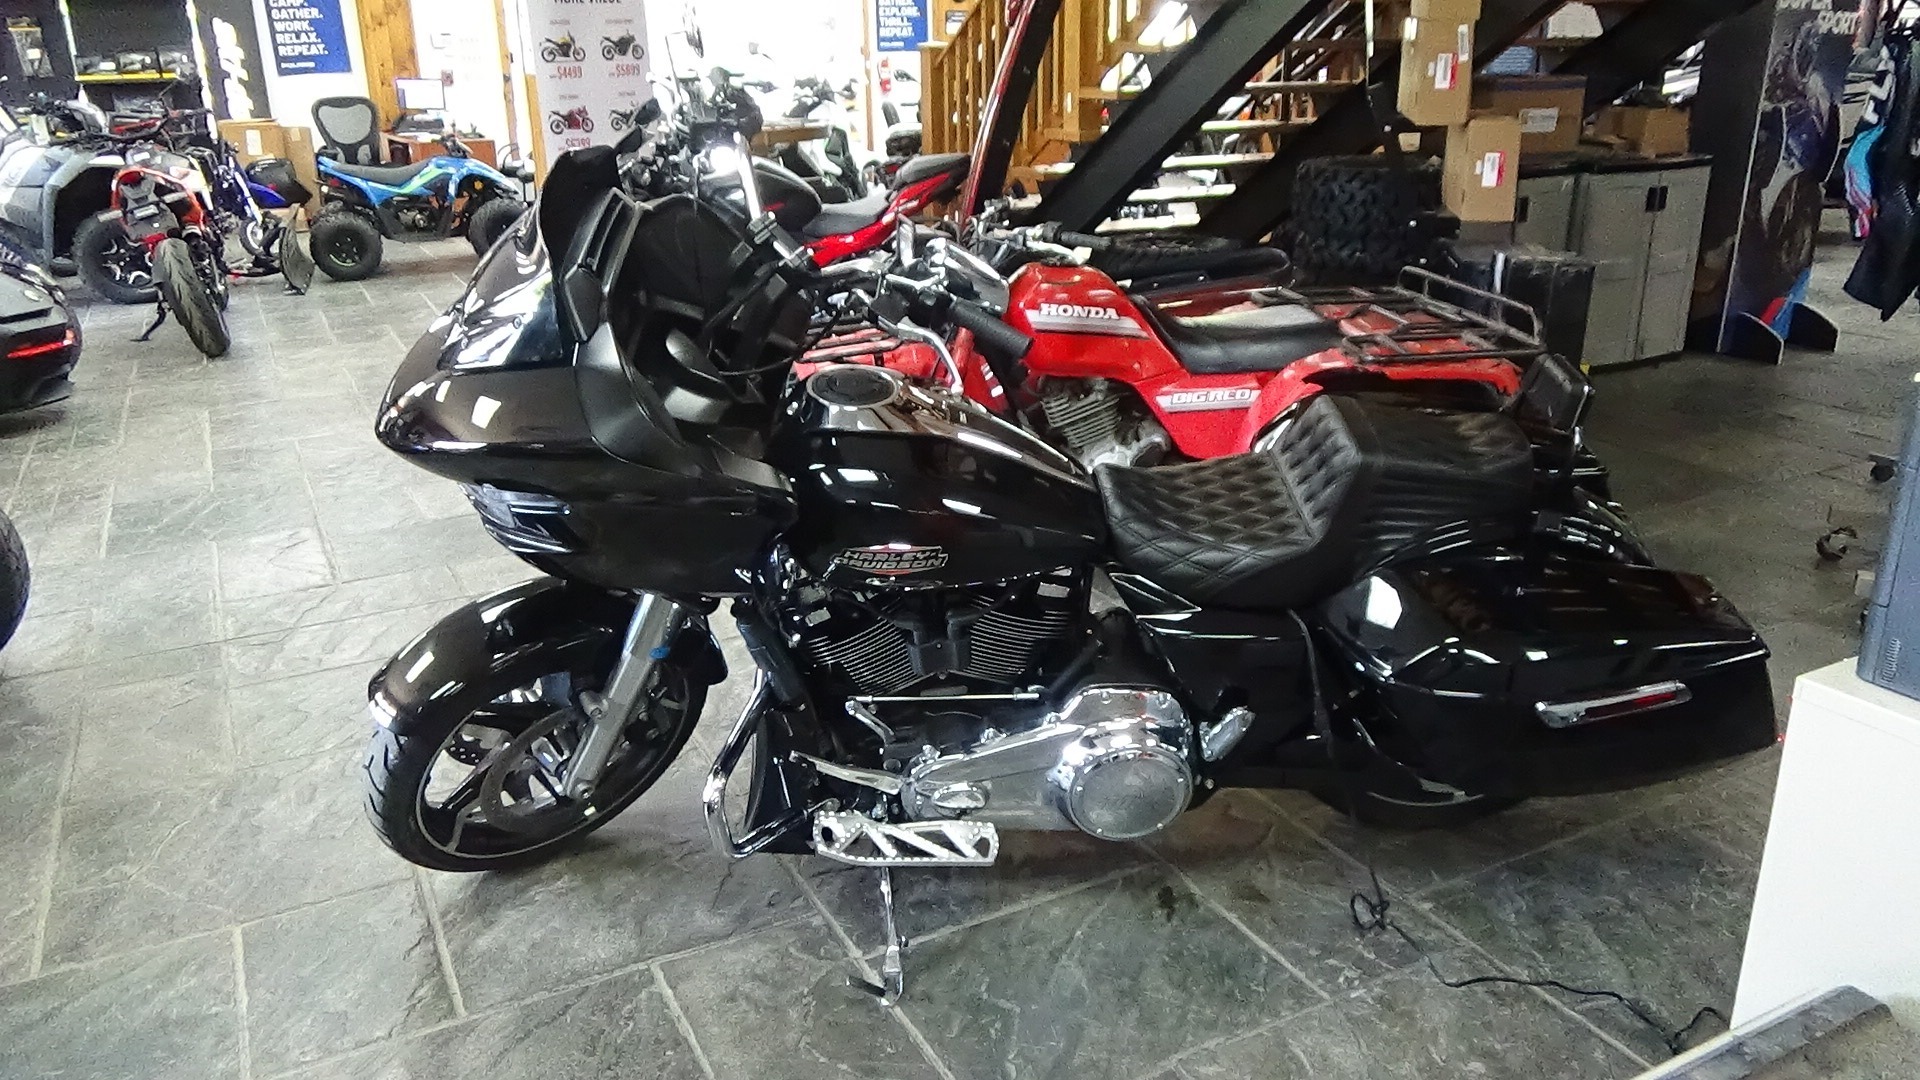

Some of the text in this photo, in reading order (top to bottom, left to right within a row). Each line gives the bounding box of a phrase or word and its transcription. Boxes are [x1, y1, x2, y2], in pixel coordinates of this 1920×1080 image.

[271, 7, 324, 20] GATHER.
[273, 20, 316, 32] WORK.
[1818, 11, 1859, 35] SPORT
[275, 32, 322, 45] RELAX.
[880, 27, 915, 38] REPEAT.
[277, 44, 329, 56] REPEAT.
[1040, 303, 1120, 320] HONDA
[1172, 388, 1251, 404] BIG RED
